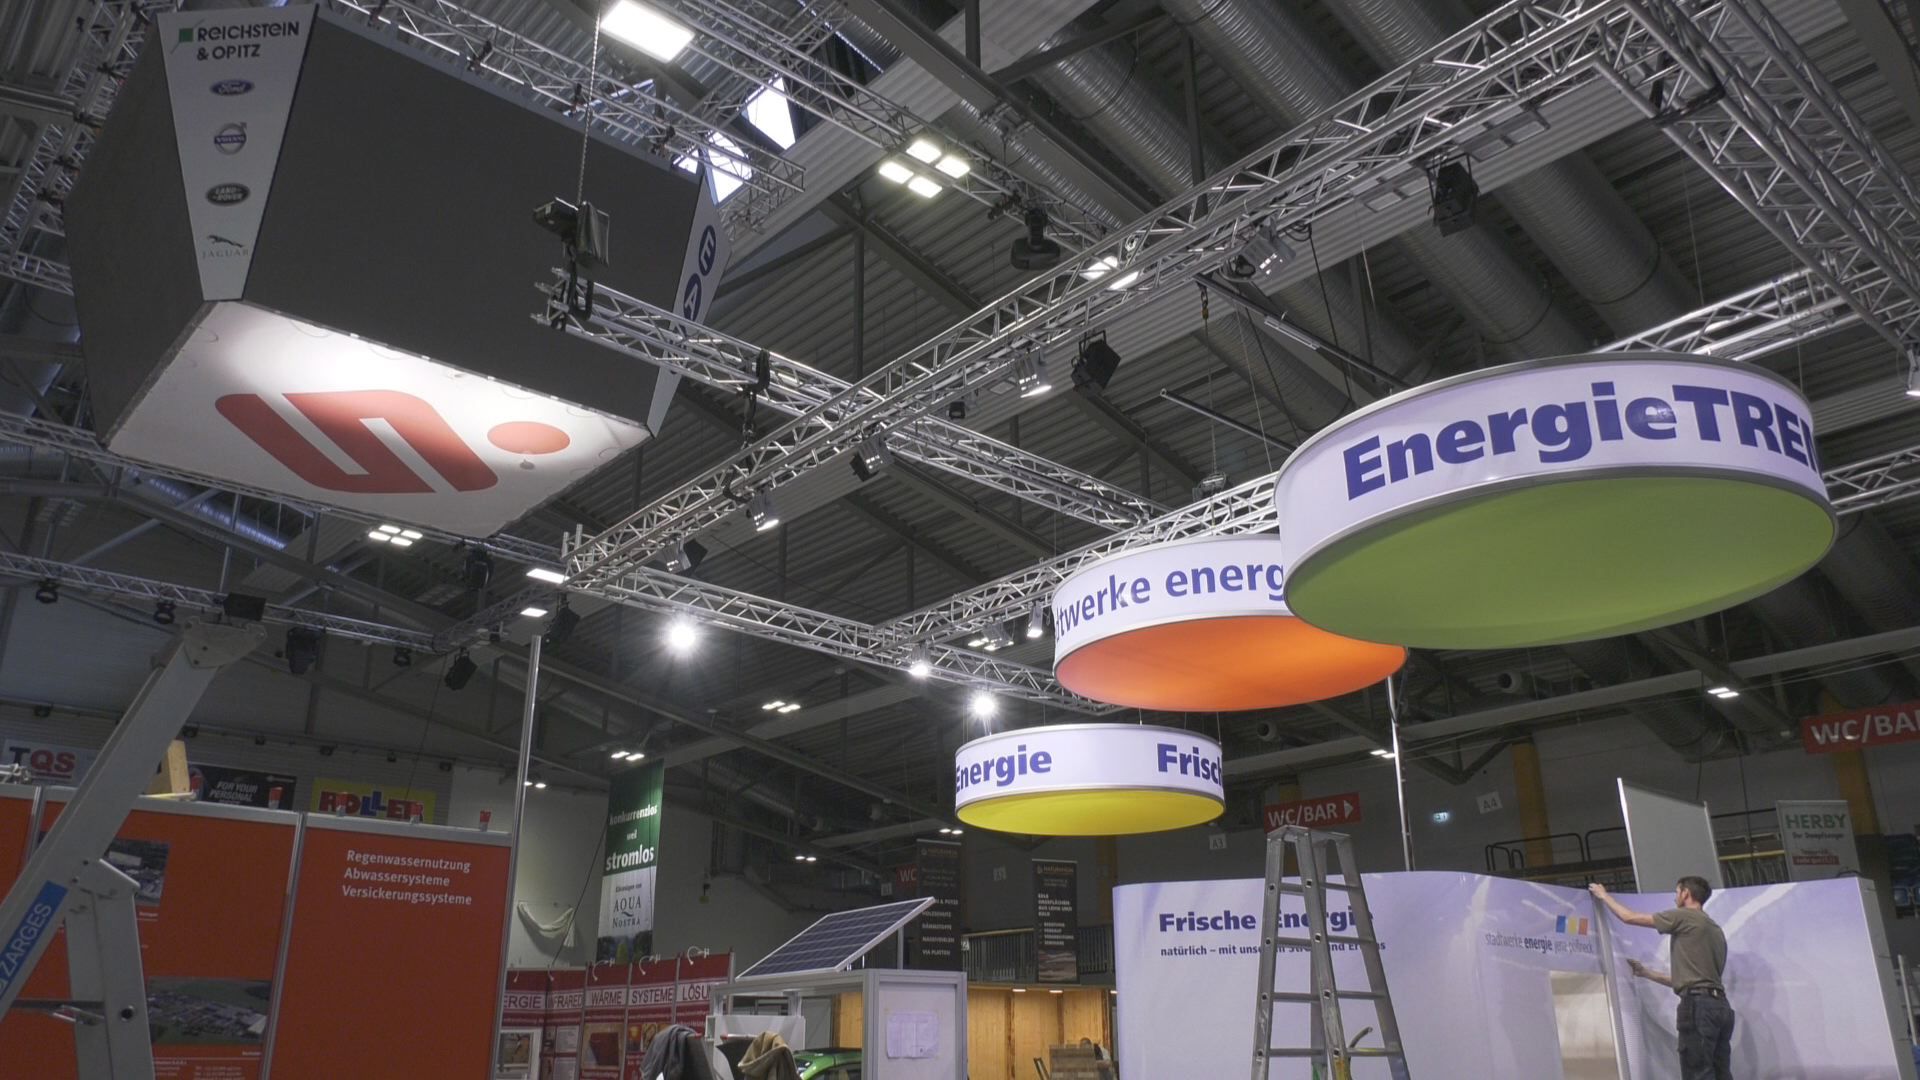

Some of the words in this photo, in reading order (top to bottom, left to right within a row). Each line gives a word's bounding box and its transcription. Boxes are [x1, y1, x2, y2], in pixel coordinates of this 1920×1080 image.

[197, 47, 209, 61] &
[212, 44, 261, 59] OPITZ
[215, 135, 245, 143] VOLVO
[202, 249, 249, 258] JAGUAR
[9, 746, 76, 772] TQS
[956, 745, 1052, 792] Energie
[209, 789, 253, 802] PERSONAL
[216, 781, 234, 790] FOR
[235, 783, 258, 793] YOUR
[609, 804, 658, 825] konkurrenzlos
[1268, 802, 1337, 828] WC/BAR
[1785, 814, 1847, 829] HERBY
[626, 828, 638, 840] weil
[347, 850, 471, 873] Regenwassernutzung
[606, 844, 654, 871] stromlos
[344, 867, 450, 886] Abwassersysteme
[900, 868, 917, 882] WC
[342, 885, 472, 905] Versickerungssysteme
[614, 896, 642, 916] AQUA
[1159, 910, 1256, 932] Frische
[0, 903, 51, 977] ZARGES
[1524, 937, 1553, 953] energie
[1160, 944, 1207, 956] natürlich
[1218, 945, 1236, 955] mit
[591, 989, 622, 1006] WÄRME
[631, 987, 673, 1004] SYSTEME
[682, 984, 711, 1001] LÖSU
